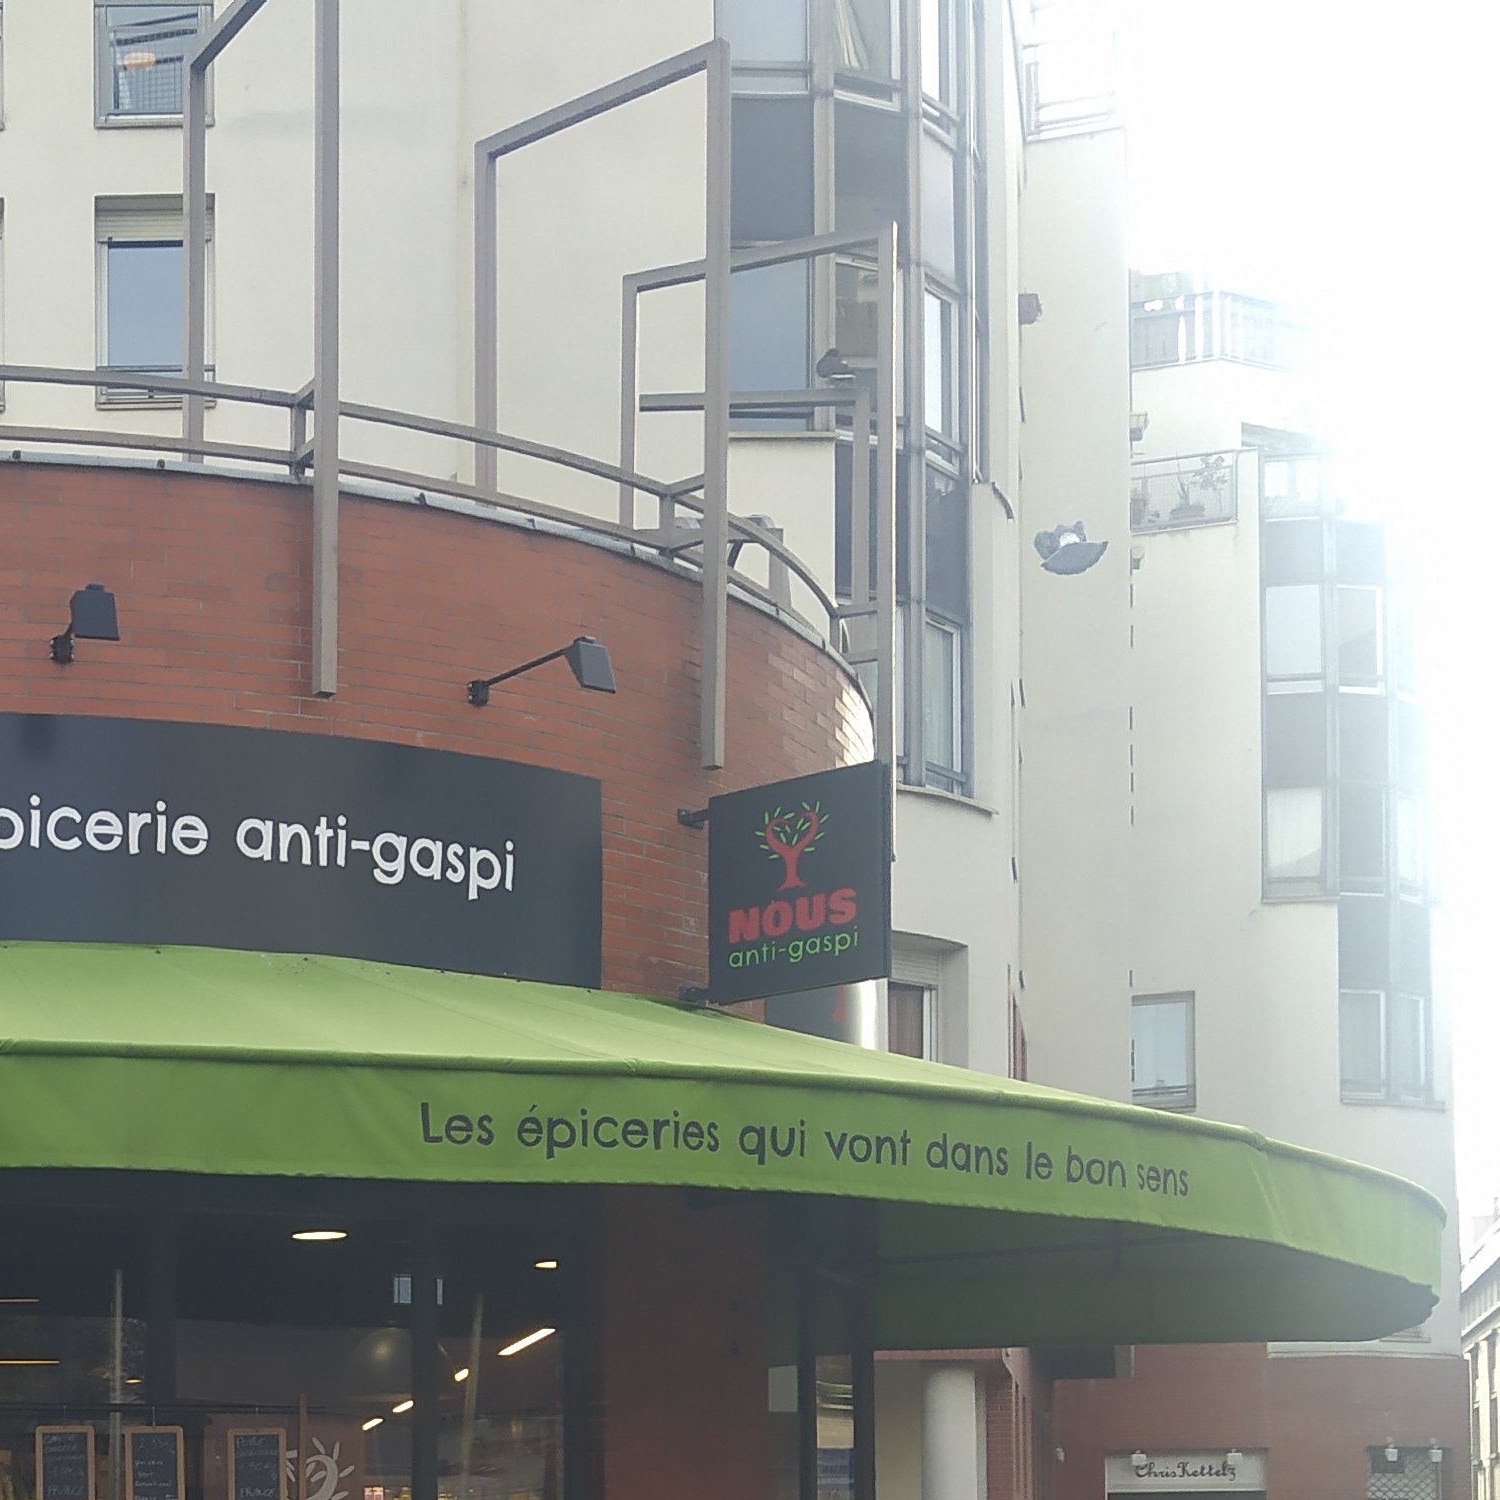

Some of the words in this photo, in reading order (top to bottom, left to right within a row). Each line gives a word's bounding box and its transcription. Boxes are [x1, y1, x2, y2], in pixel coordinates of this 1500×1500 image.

[236, 815, 516, 900] anti-gaspi
[728, 887, 857, 944] NOUS
[728, 926, 859, 968] anti-gaspi
[420, 1102, 494, 1146] Les
[517, 1104, 720, 1159] épiceries
[739, 1120, 806, 1165] qui
[824, 1129, 911, 1166] vont
[926, 1133, 1009, 1176] dans
[1026, 1141, 1053, 1180] le
[1066, 1145, 1127, 1188] bon
[1137, 1162, 1189, 1197] sens
